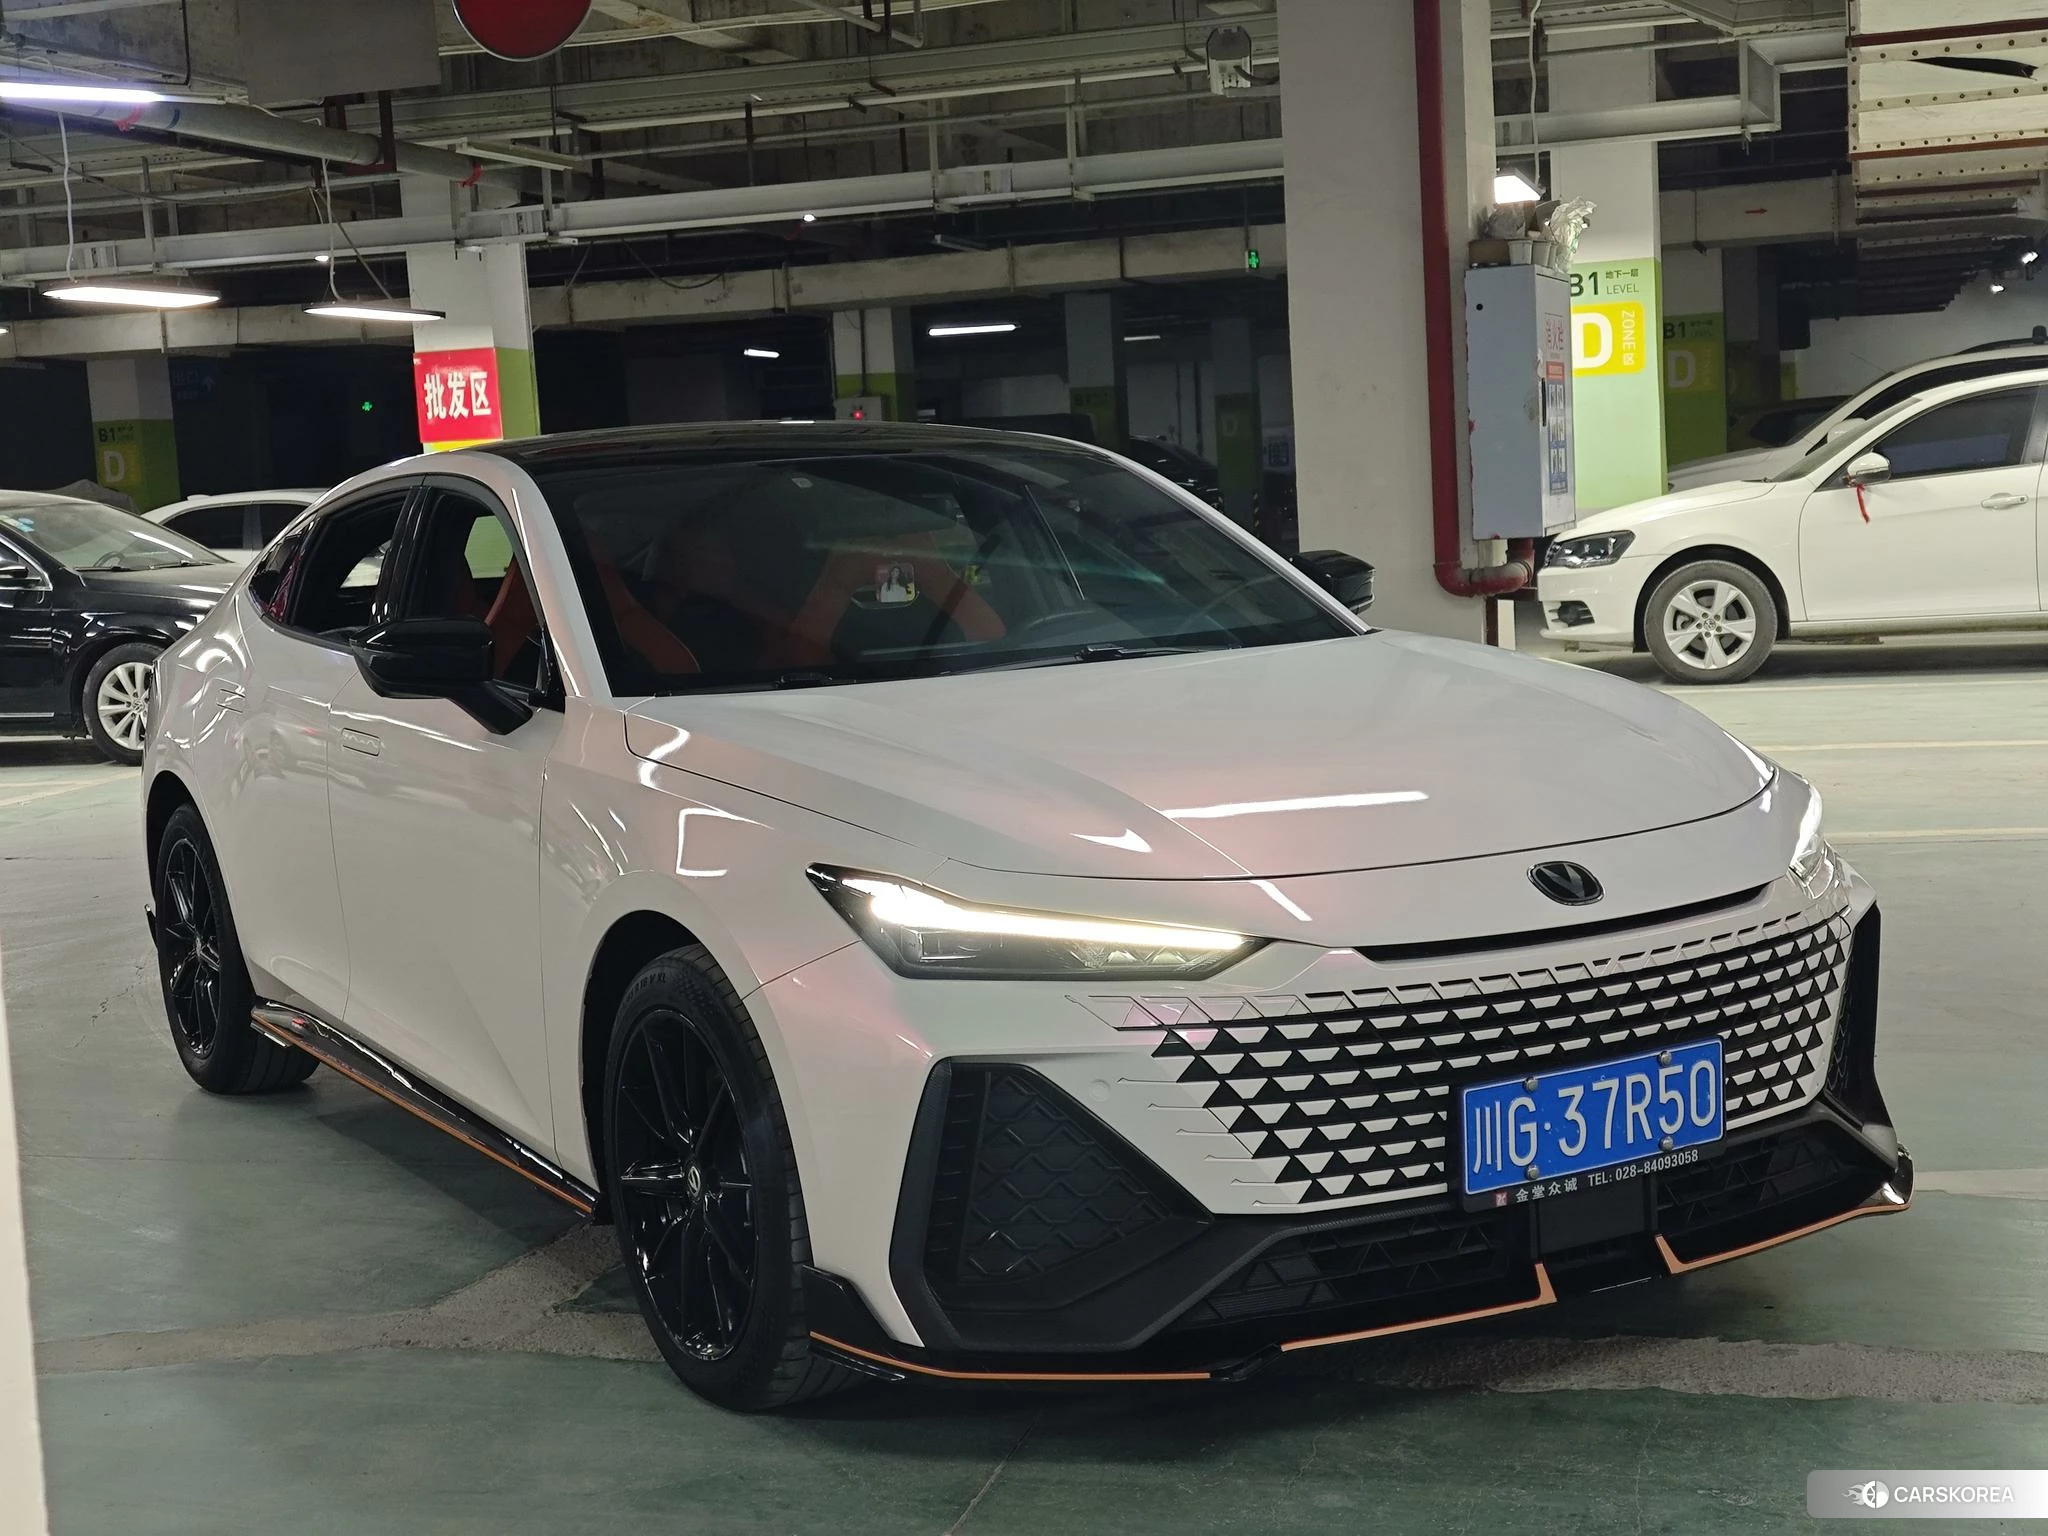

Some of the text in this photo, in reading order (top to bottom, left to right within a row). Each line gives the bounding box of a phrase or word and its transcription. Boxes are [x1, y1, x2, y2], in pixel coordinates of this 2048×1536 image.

[1570, 271, 1599, 297] B1
[1606, 283, 1640, 295] LEVEL
[1571, 312, 1613, 369] D
[1622, 310, 1636, 352] ZONE
[1663, 321, 1686, 339] B1
[1667, 350, 1696, 388] D
[423, 371, 491, 420] 批发区
[98, 427, 116, 442] B1
[103, 450, 125, 482] D
[1472, 1060, 1716, 1174] 川G·37R50
[1515, 1177, 1578, 1203] 金堂众诚
[1588, 1172, 1613, 1187] TEL:
[1615, 1149, 1699, 1181] 028-84093058
